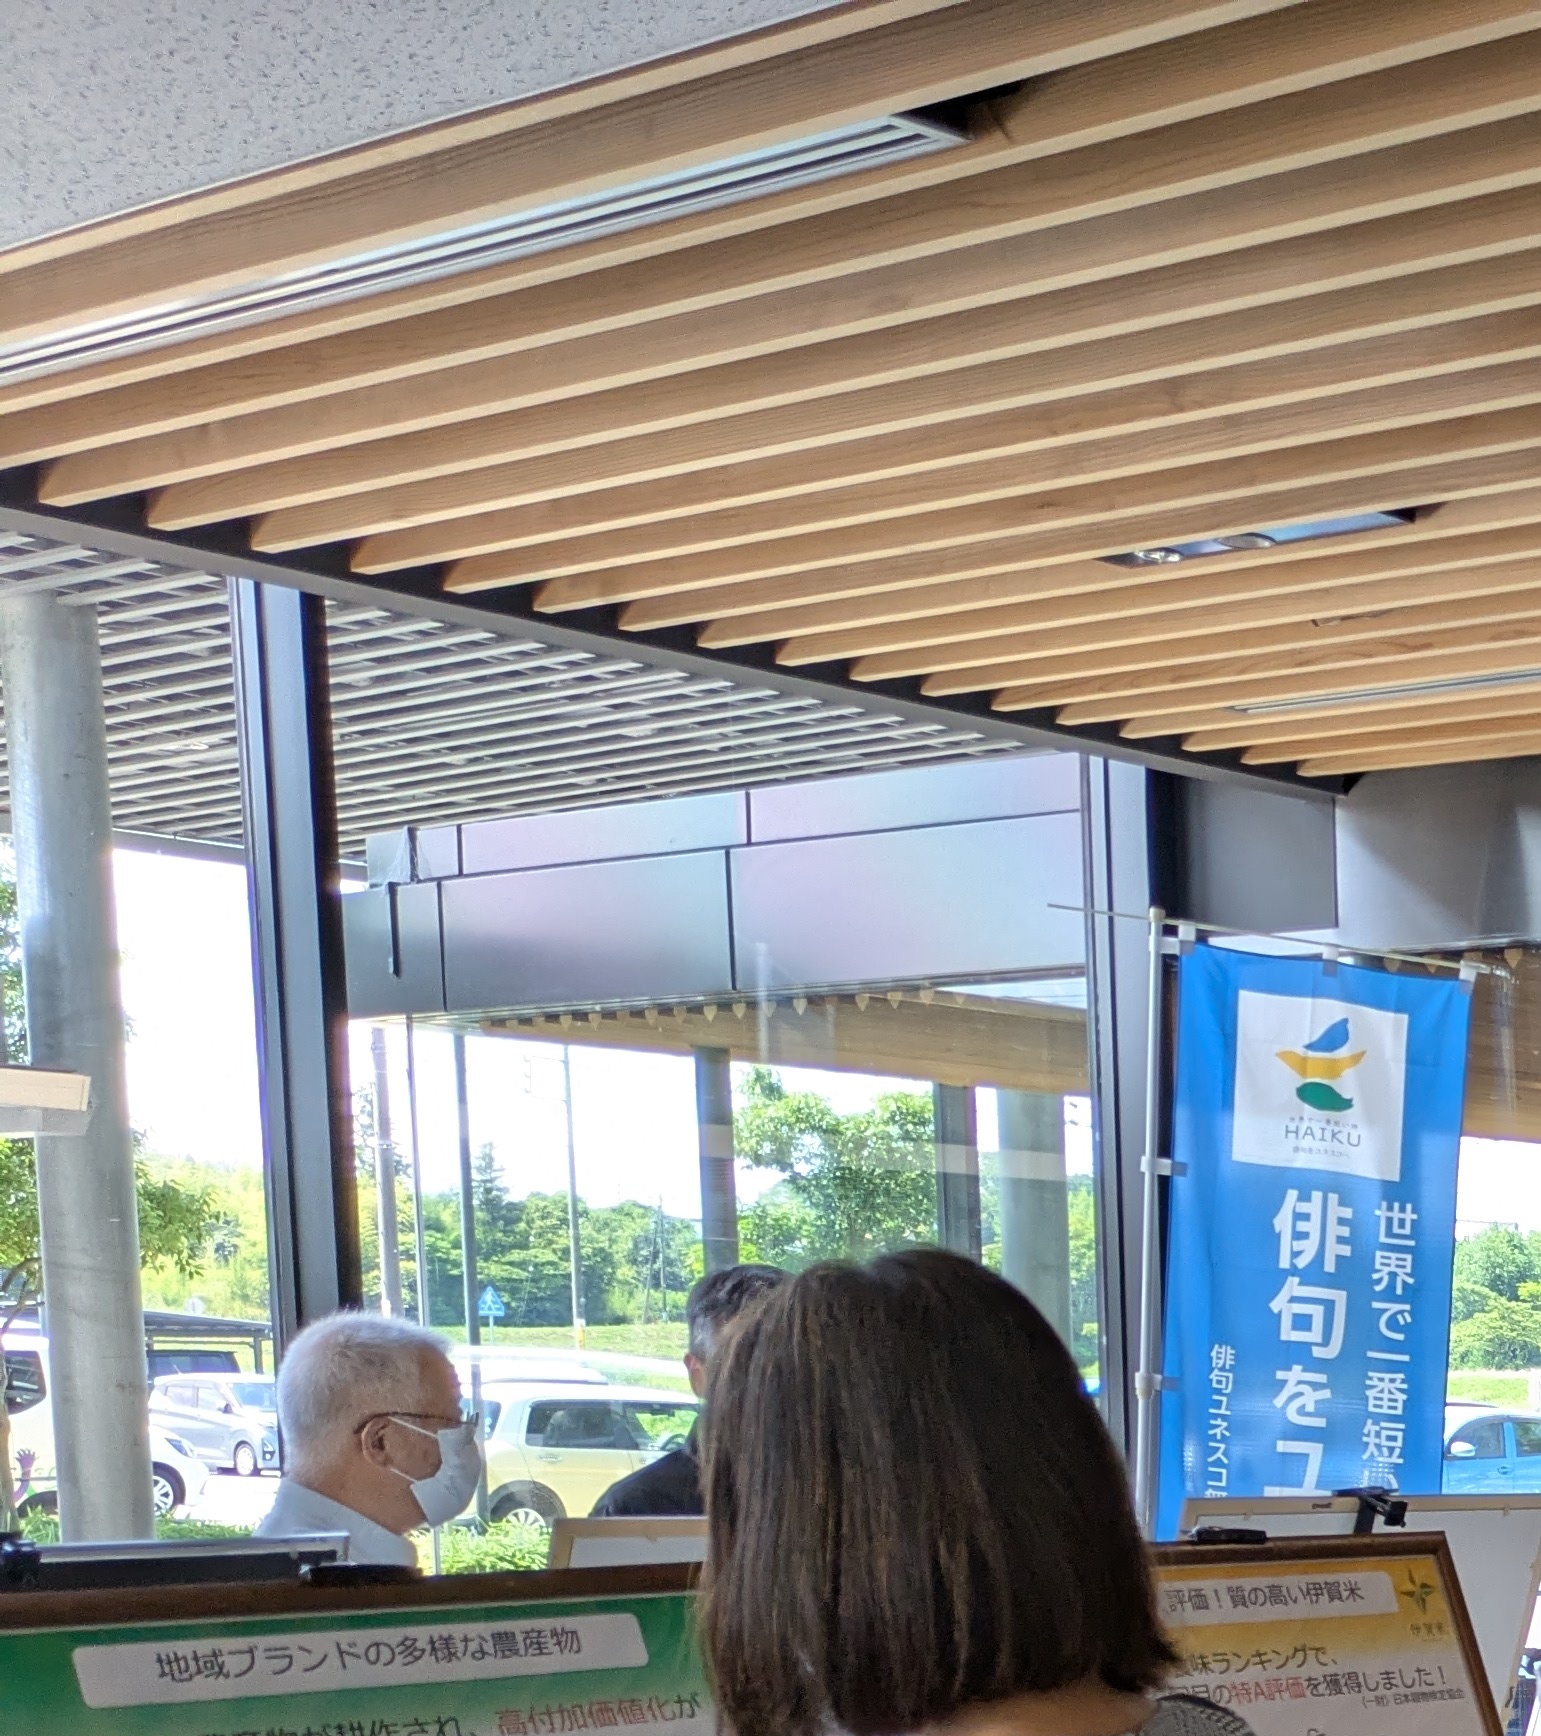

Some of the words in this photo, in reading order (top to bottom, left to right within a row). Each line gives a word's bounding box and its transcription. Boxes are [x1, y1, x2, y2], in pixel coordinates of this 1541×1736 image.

[1284, 1124, 1361, 1148] HAIKU
[156, 1626, 582, 1683] 地域ブランドの多様な農産物
